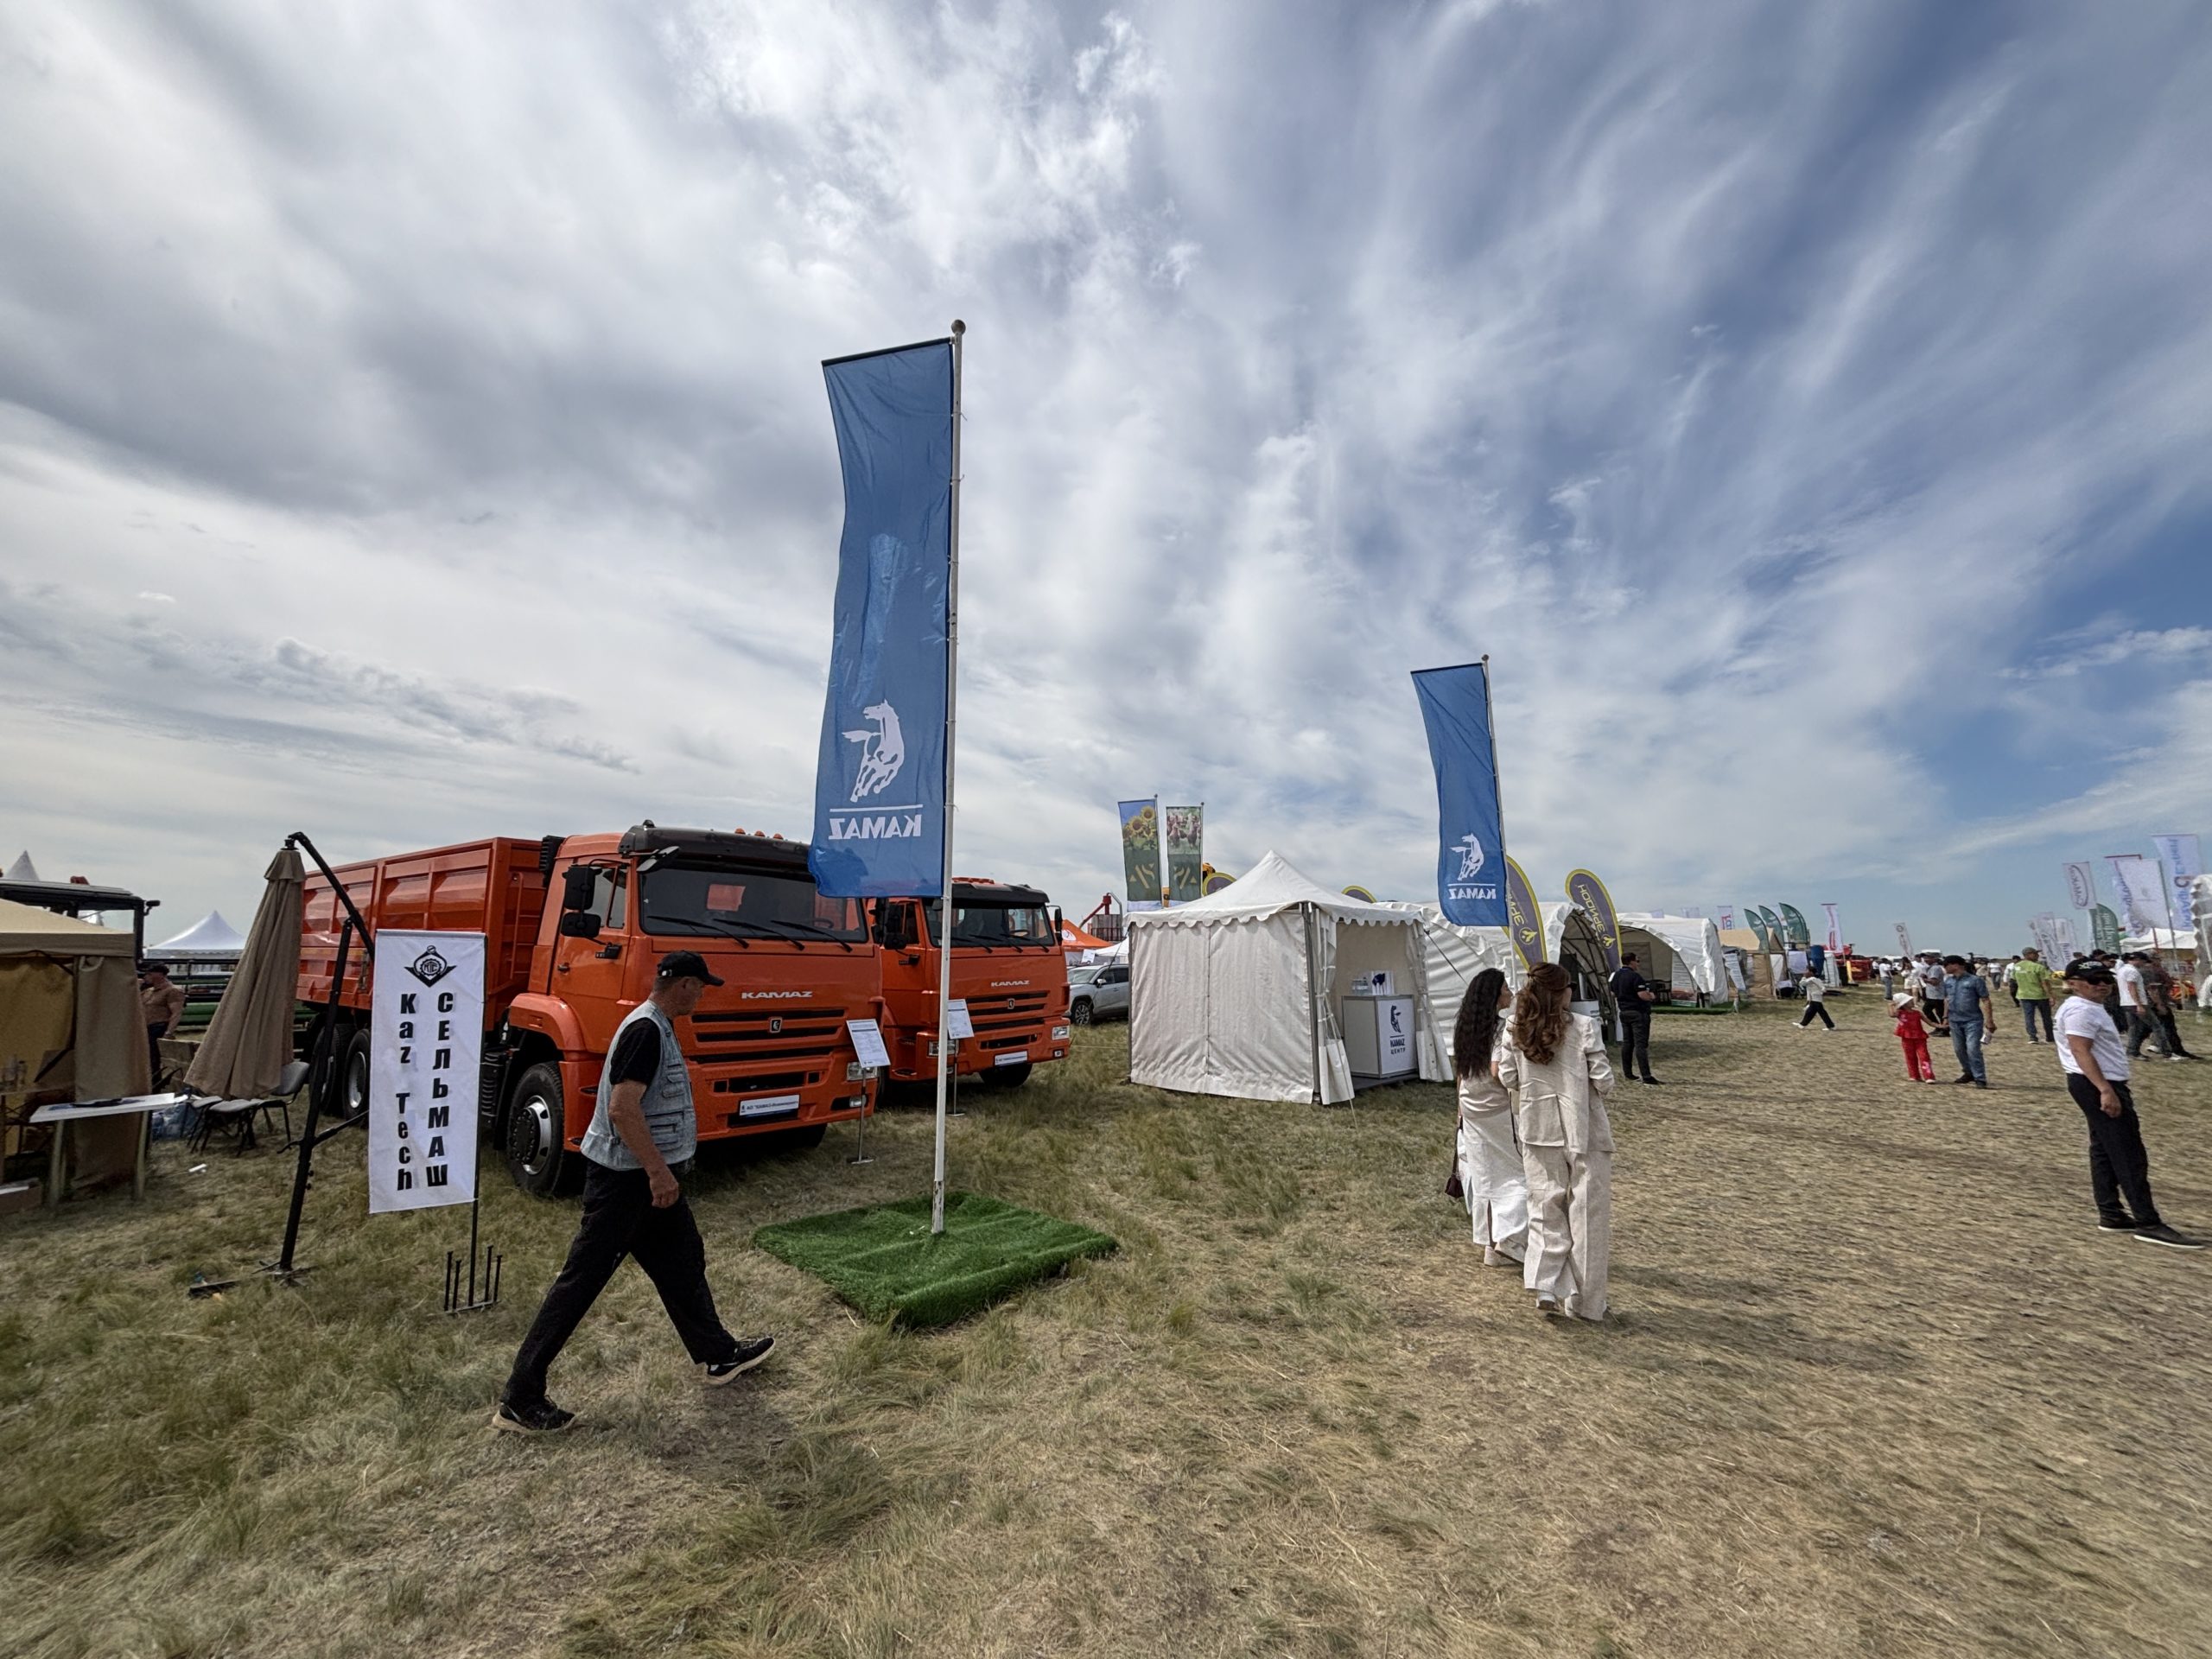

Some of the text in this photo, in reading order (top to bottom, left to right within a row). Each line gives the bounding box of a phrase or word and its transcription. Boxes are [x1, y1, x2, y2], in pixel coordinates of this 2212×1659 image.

[1577, 884, 1605, 933] ЭРИДОН
[396, 993, 416, 1191] Kaz Tech
[426, 992, 454, 1187] СЕЛЬМАШ
